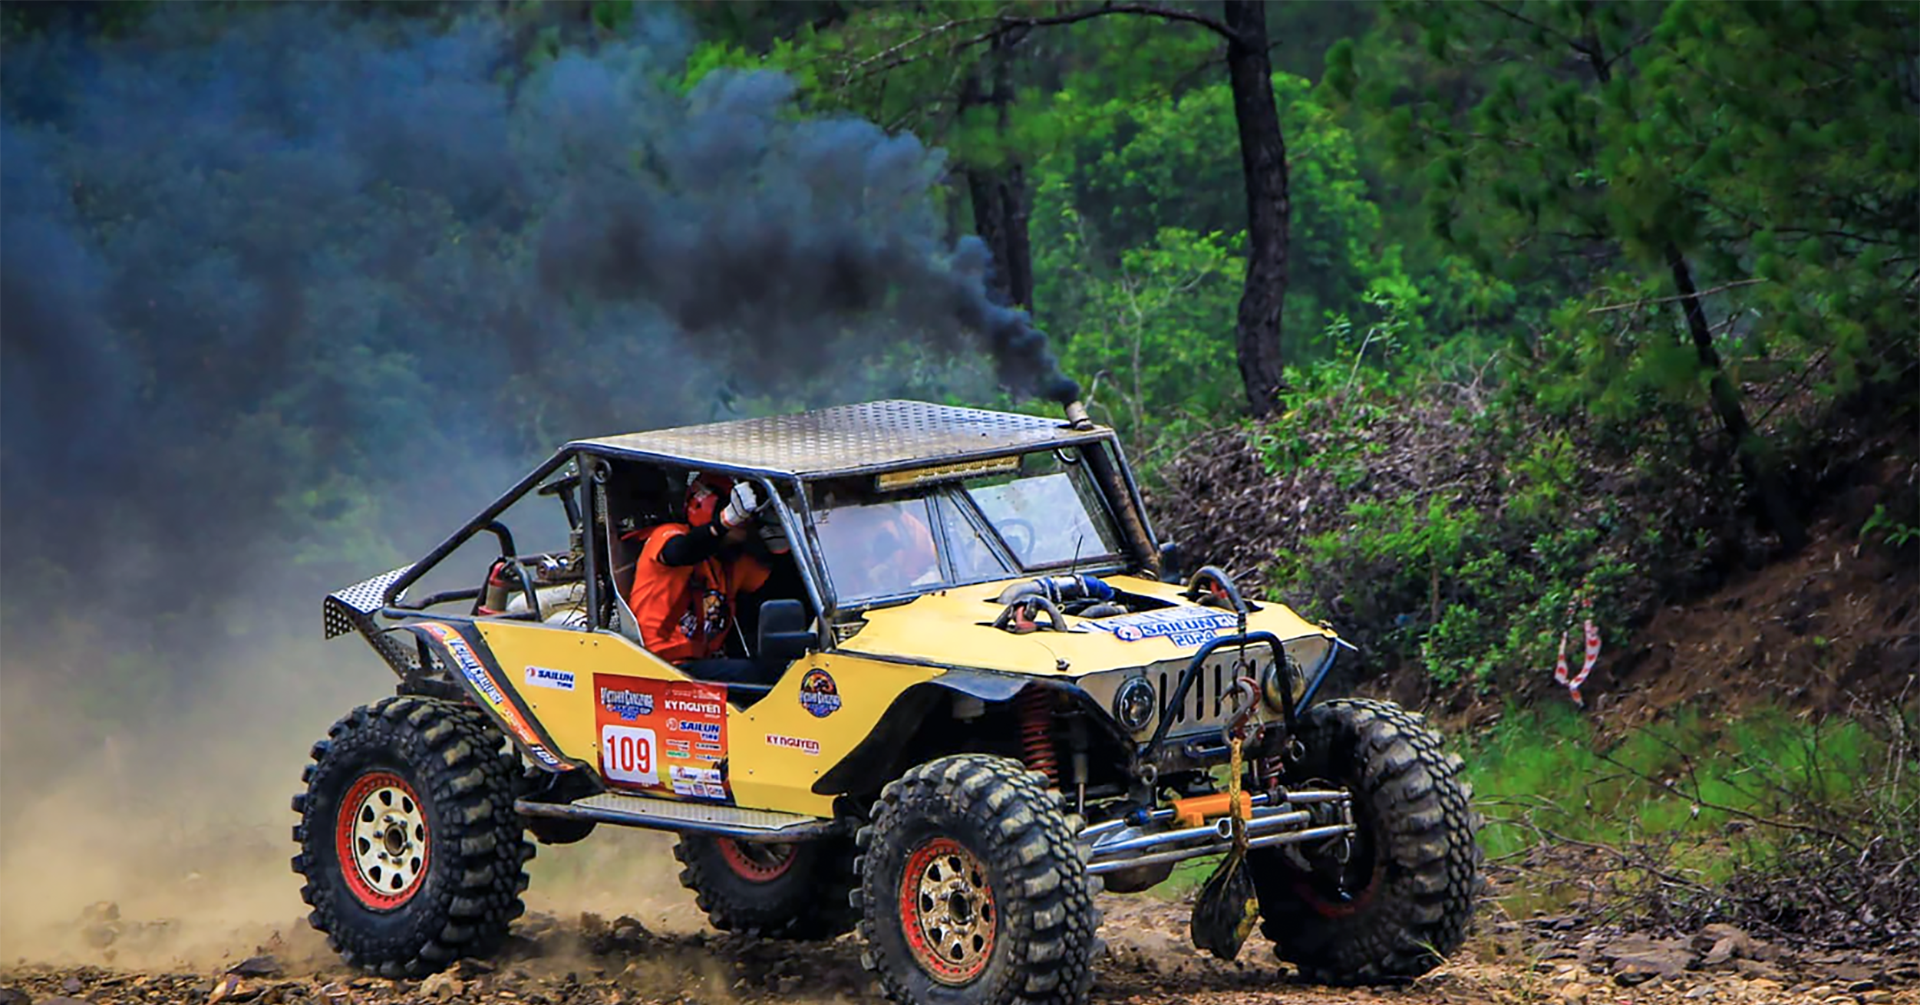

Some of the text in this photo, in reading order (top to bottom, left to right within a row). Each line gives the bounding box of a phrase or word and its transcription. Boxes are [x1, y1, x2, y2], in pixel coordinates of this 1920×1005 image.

[1142, 616, 1217, 635] SAILUN
[1172, 630, 1216, 647] 2024
[537, 669, 574, 682] SAILUN
[680, 720, 720, 732] SAILUN
[531, 746, 559, 765] 109
[607, 735, 650, 774] 109
